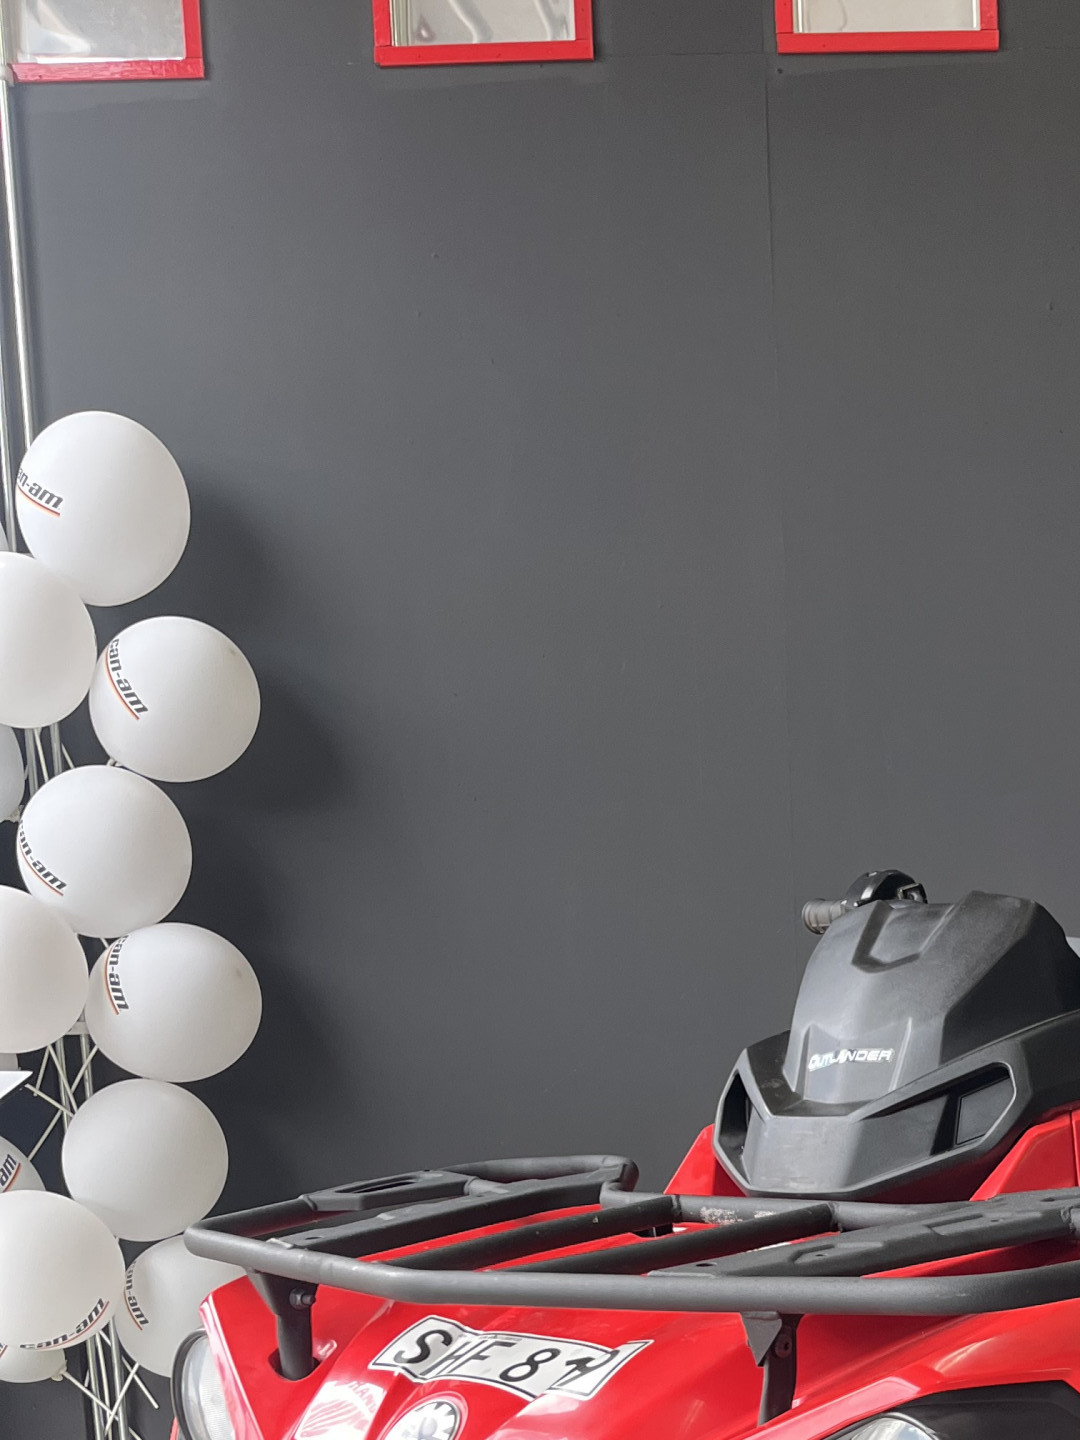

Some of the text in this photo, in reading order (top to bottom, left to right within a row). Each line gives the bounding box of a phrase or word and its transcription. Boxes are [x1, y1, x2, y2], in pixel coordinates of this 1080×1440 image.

[17, 467, 64, 509] an-am
[109, 638, 149, 713] can-am
[808, 1048, 895, 1072] OUTLANDER
[20, 1298, 104, 1350] can-am
